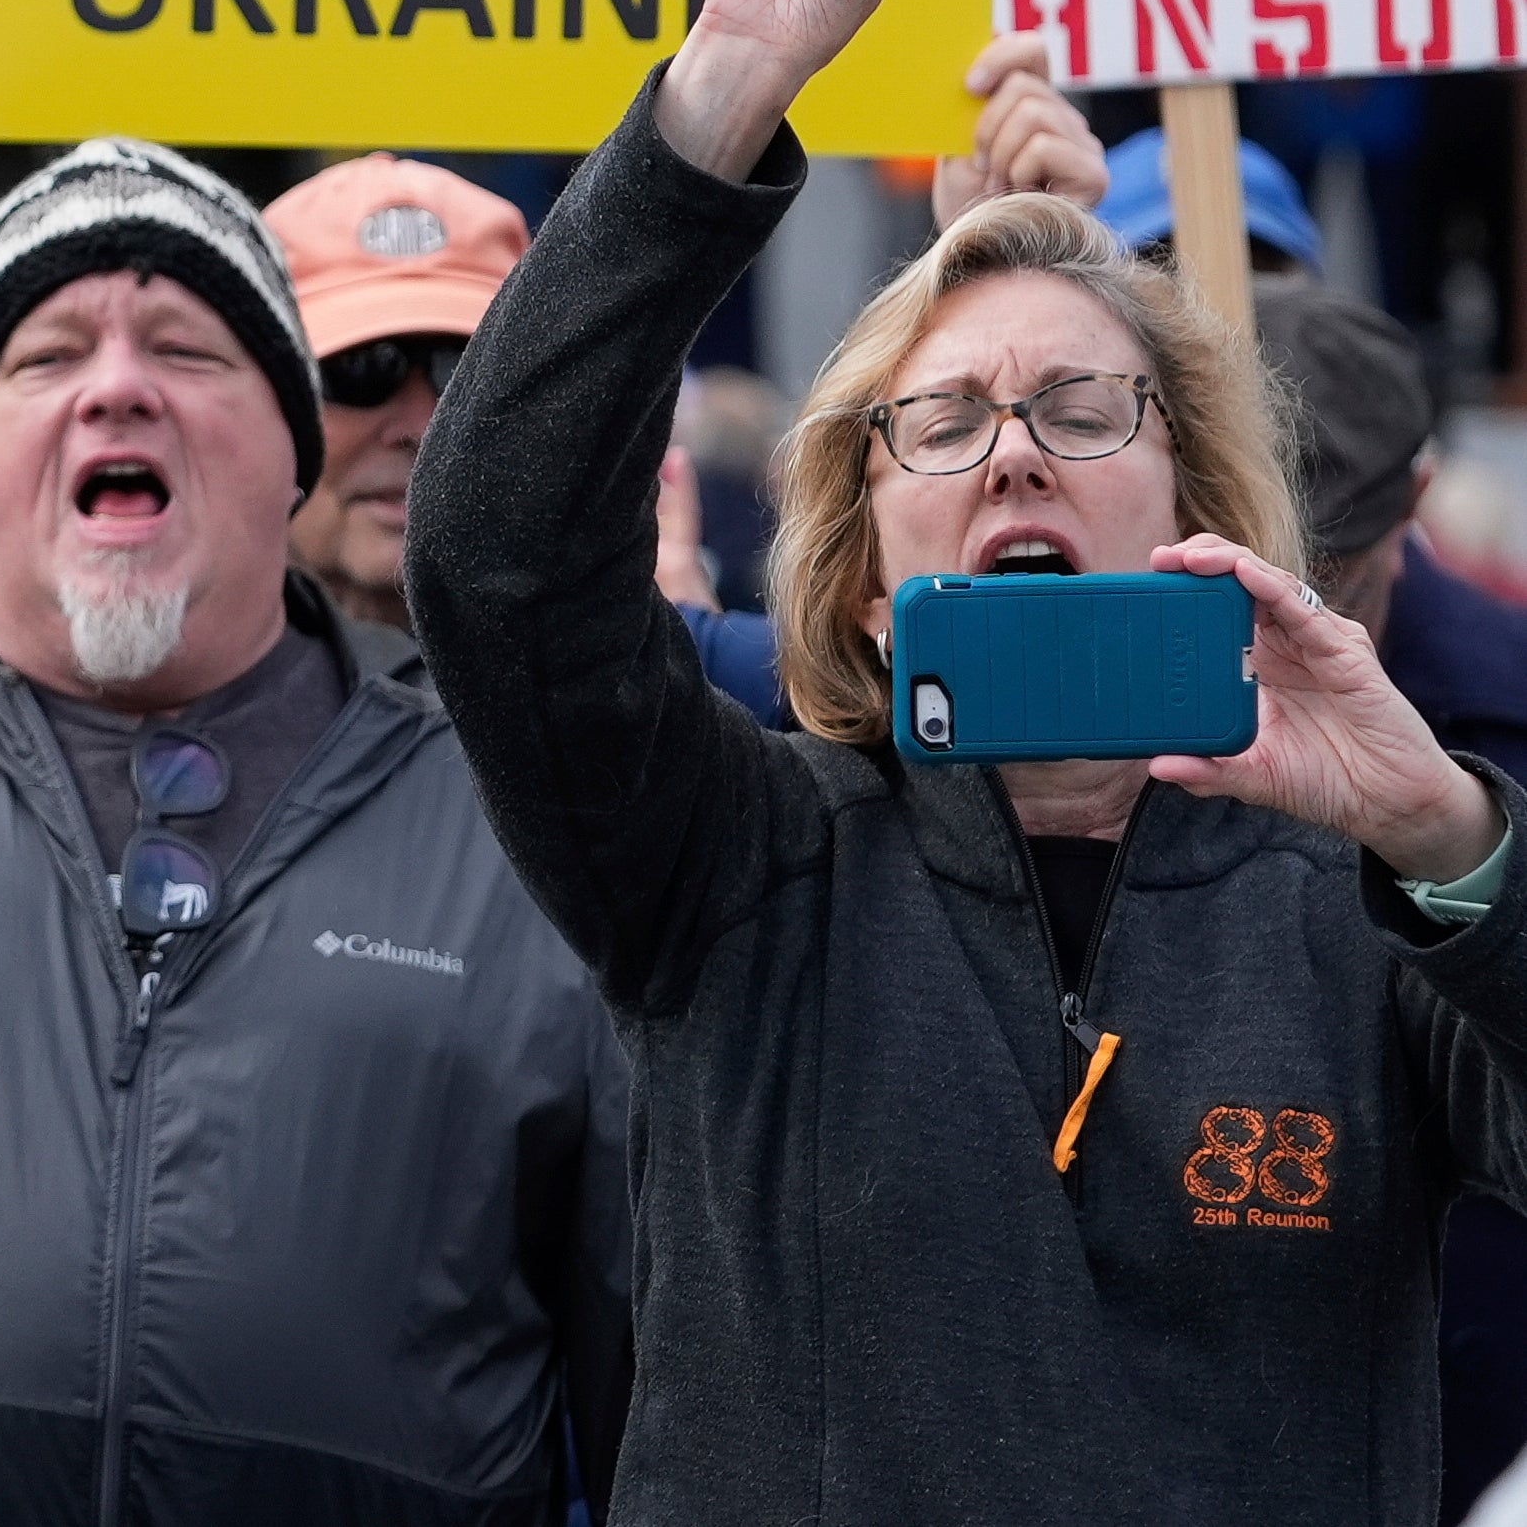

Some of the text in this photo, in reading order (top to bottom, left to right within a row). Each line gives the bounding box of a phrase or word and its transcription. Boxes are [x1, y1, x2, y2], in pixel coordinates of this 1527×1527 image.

[344, 934, 465, 975] Columbia
[1183, 1105, 1335, 1207] 88
[1193, 1206, 1332, 1231] 25th Reunion
